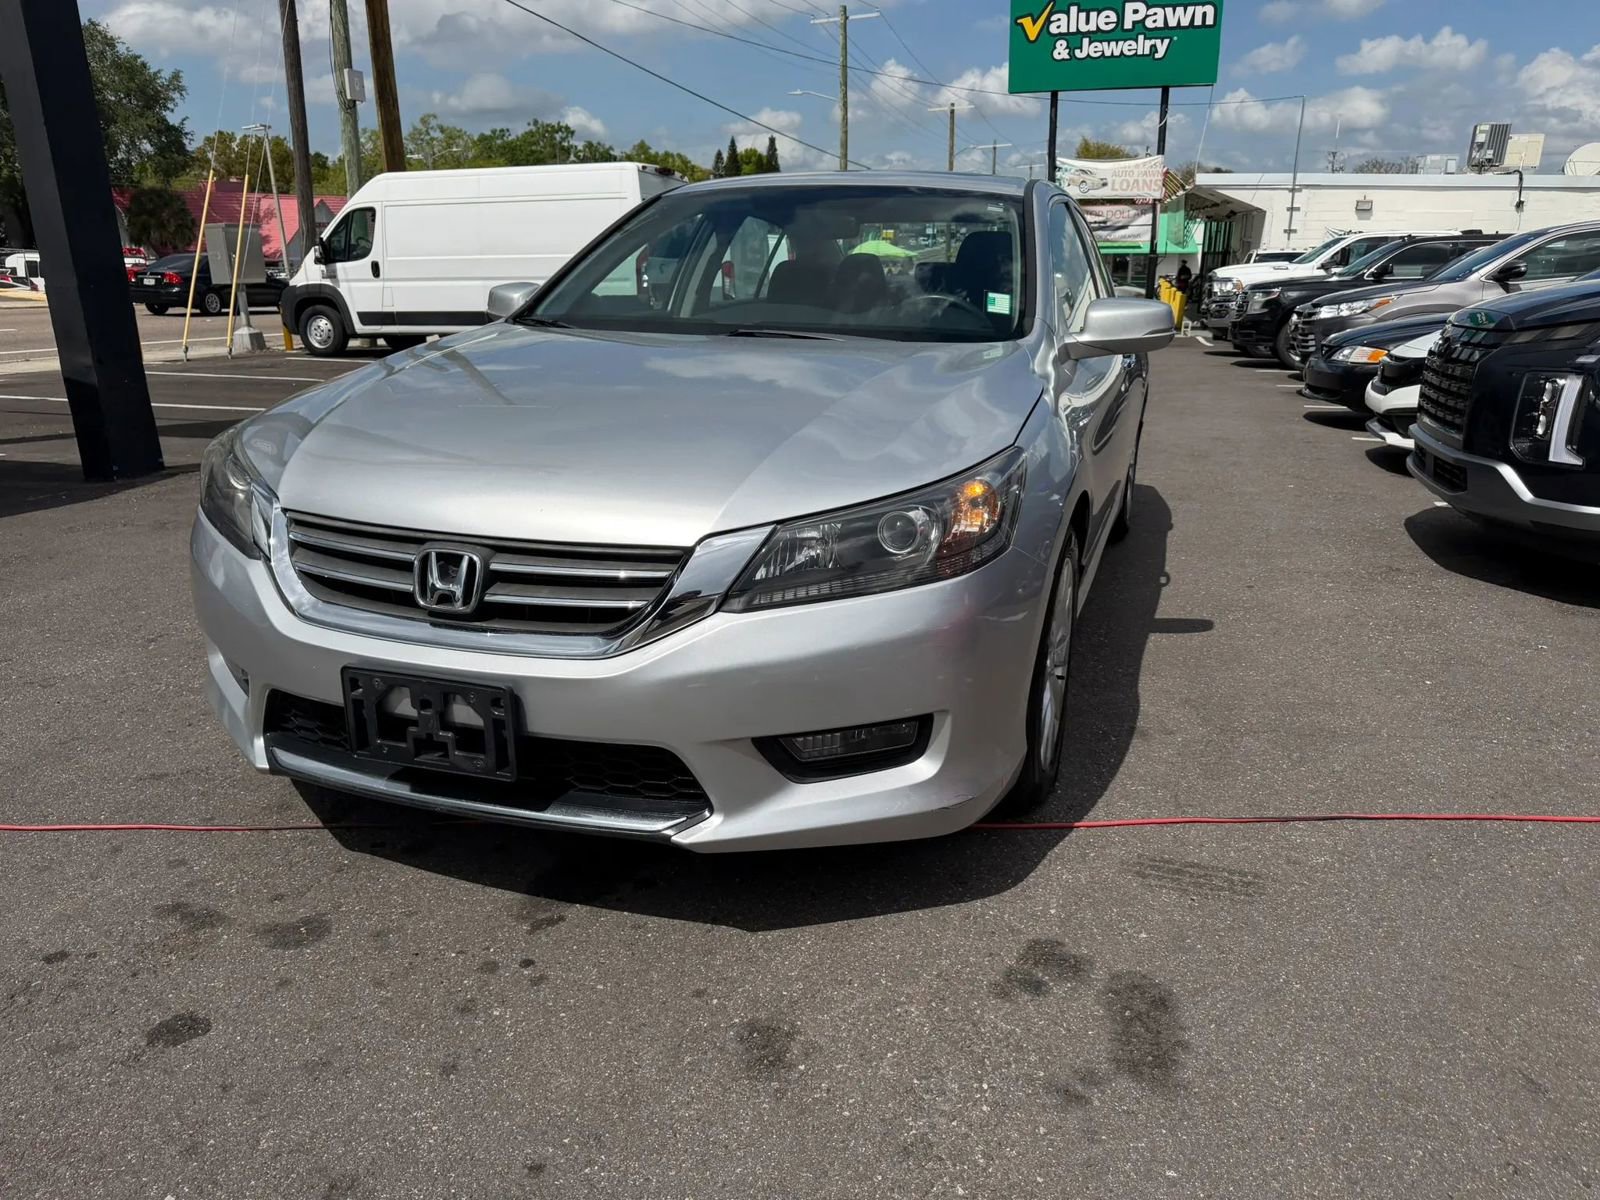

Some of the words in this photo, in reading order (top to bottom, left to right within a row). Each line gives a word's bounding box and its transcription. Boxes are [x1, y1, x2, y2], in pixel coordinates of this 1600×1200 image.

[1123, 2, 1215, 30] Pawn
[1052, 39, 1071, 60] &
[1074, 34, 1170, 59] Jewelry
[1111, 169, 1135, 178] AUTO
[1110, 178, 1162, 192] LOANS
